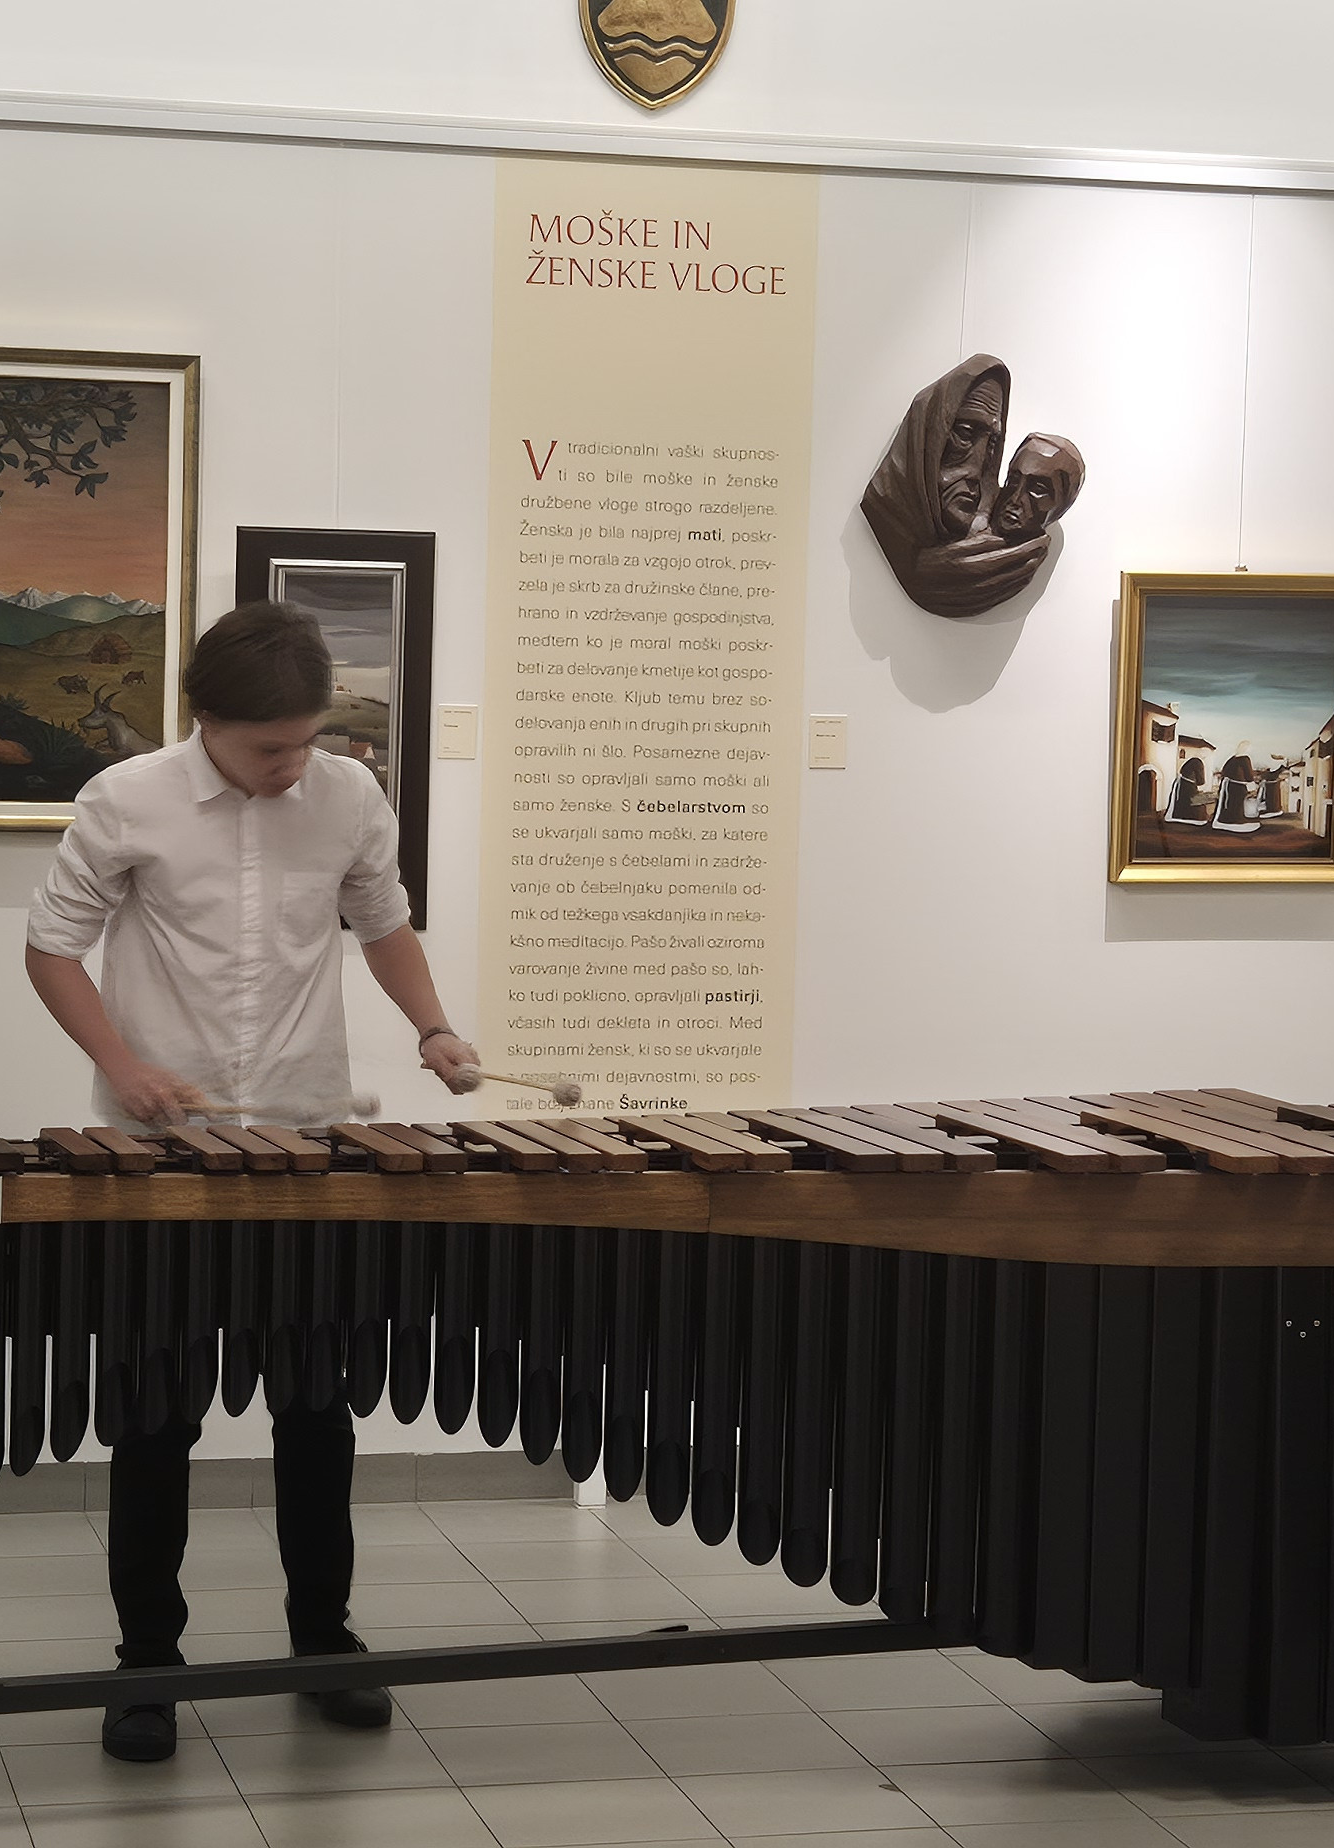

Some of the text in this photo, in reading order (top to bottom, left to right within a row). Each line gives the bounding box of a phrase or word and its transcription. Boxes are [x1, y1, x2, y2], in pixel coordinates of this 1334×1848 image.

[529, 209, 712, 251] MOŠKE IN
[524, 249, 788, 296] ŽENSKE VLOGE
[522, 439, 780, 481] V tradicionalni vaški skupnos-
[558, 469, 779, 489] ti so bile moške in ženske
[521, 495, 592, 510] družbene
[598, 497, 638, 515] vloge
[645, 499, 692, 515] strogo
[519, 519, 573, 537] Ženska
[579, 525, 592, 540] je
[599, 525, 624, 539] bila
[631, 526, 681, 543] najprej
[731, 530, 777, 543] poskr-
[519, 551, 776, 572] beti je morala za vzgojo otrok, prev-
[518, 579, 775, 600] zela je skrb za družinske člane, pre-
[518, 606, 560, 620] hrano
[566, 608, 578, 621] in
[517, 635, 773, 653] medtem ko je moral moški poskr-
[517, 661, 773, 682] beti za delovanje kmetije kot gospo-
[516, 689, 565, 701] darske
[624, 691, 661, 707] Kljub
[668, 693, 705, 705] temu
[712, 693, 743, 706] brez
[750, 696, 772, 706] so-
[515, 717, 771, 735] delovanja enih in drugih pri skupnih
[514, 745, 576, 758] opravilih
[583, 747, 596, 758] ni
[633, 745, 720, 759] Posamezne
[726, 748, 771, 763] dejav-
[514, 772, 769, 788] nosti so opravljali samo moški ali
[513, 801, 554, 811] samo
[621, 800, 631, 813] S
[637, 799, 746, 814] čebelarstvom
[751, 804, 769, 814] so
[512, 828, 529, 839] se
[535, 826, 597, 843] ukvarjali
[601, 829, 644, 839] samo
[701, 831, 717, 841] za
[723, 828, 768, 842] katere
[511, 853, 767, 869] sta druženje s čebelami in zadrže-
[511, 881, 766, 897] vanje ob čebelnjaku pomenila od-
[511, 908, 536, 921] mik
[540, 909, 559, 921] od
[563, 909, 618, 923] težkega
[710, 910, 723, 921] in
[510, 935, 544, 947] kšno
[631, 935, 667, 948] Pašo
[669, 935, 704, 948] živali
[707, 937, 765, 949] oziroma
[509, 964, 580, 977] varovanje
[585, 962, 628, 975] živine
[633, 962, 666, 975] med
[671, 962, 707, 976] pašo
[508, 989, 525, 1002] ko
[530, 990, 558, 1002] tudi
[634, 990, 700, 1004] opravljali
[705, 990, 763, 1005] pastirji,
[507, 1017, 555, 1029] včasih
[562, 1017, 590, 1029] tudi
[657, 1018, 670, 1029] in
[729, 1016, 763, 1029] Med
[507, 1044, 583, 1057] skupinami
[639, 1044, 650, 1056] ki
[654, 1046, 671, 1056] so
[675, 1046, 692, 1056] se
[696, 1044, 762, 1059] ukvarjale
[606, 1070, 700, 1085] dejavnostmi,
[706, 1072, 723, 1083] so
[729, 1073, 761, 1085] pos-
[619, 1093, 688, 1110] Šavrinke
